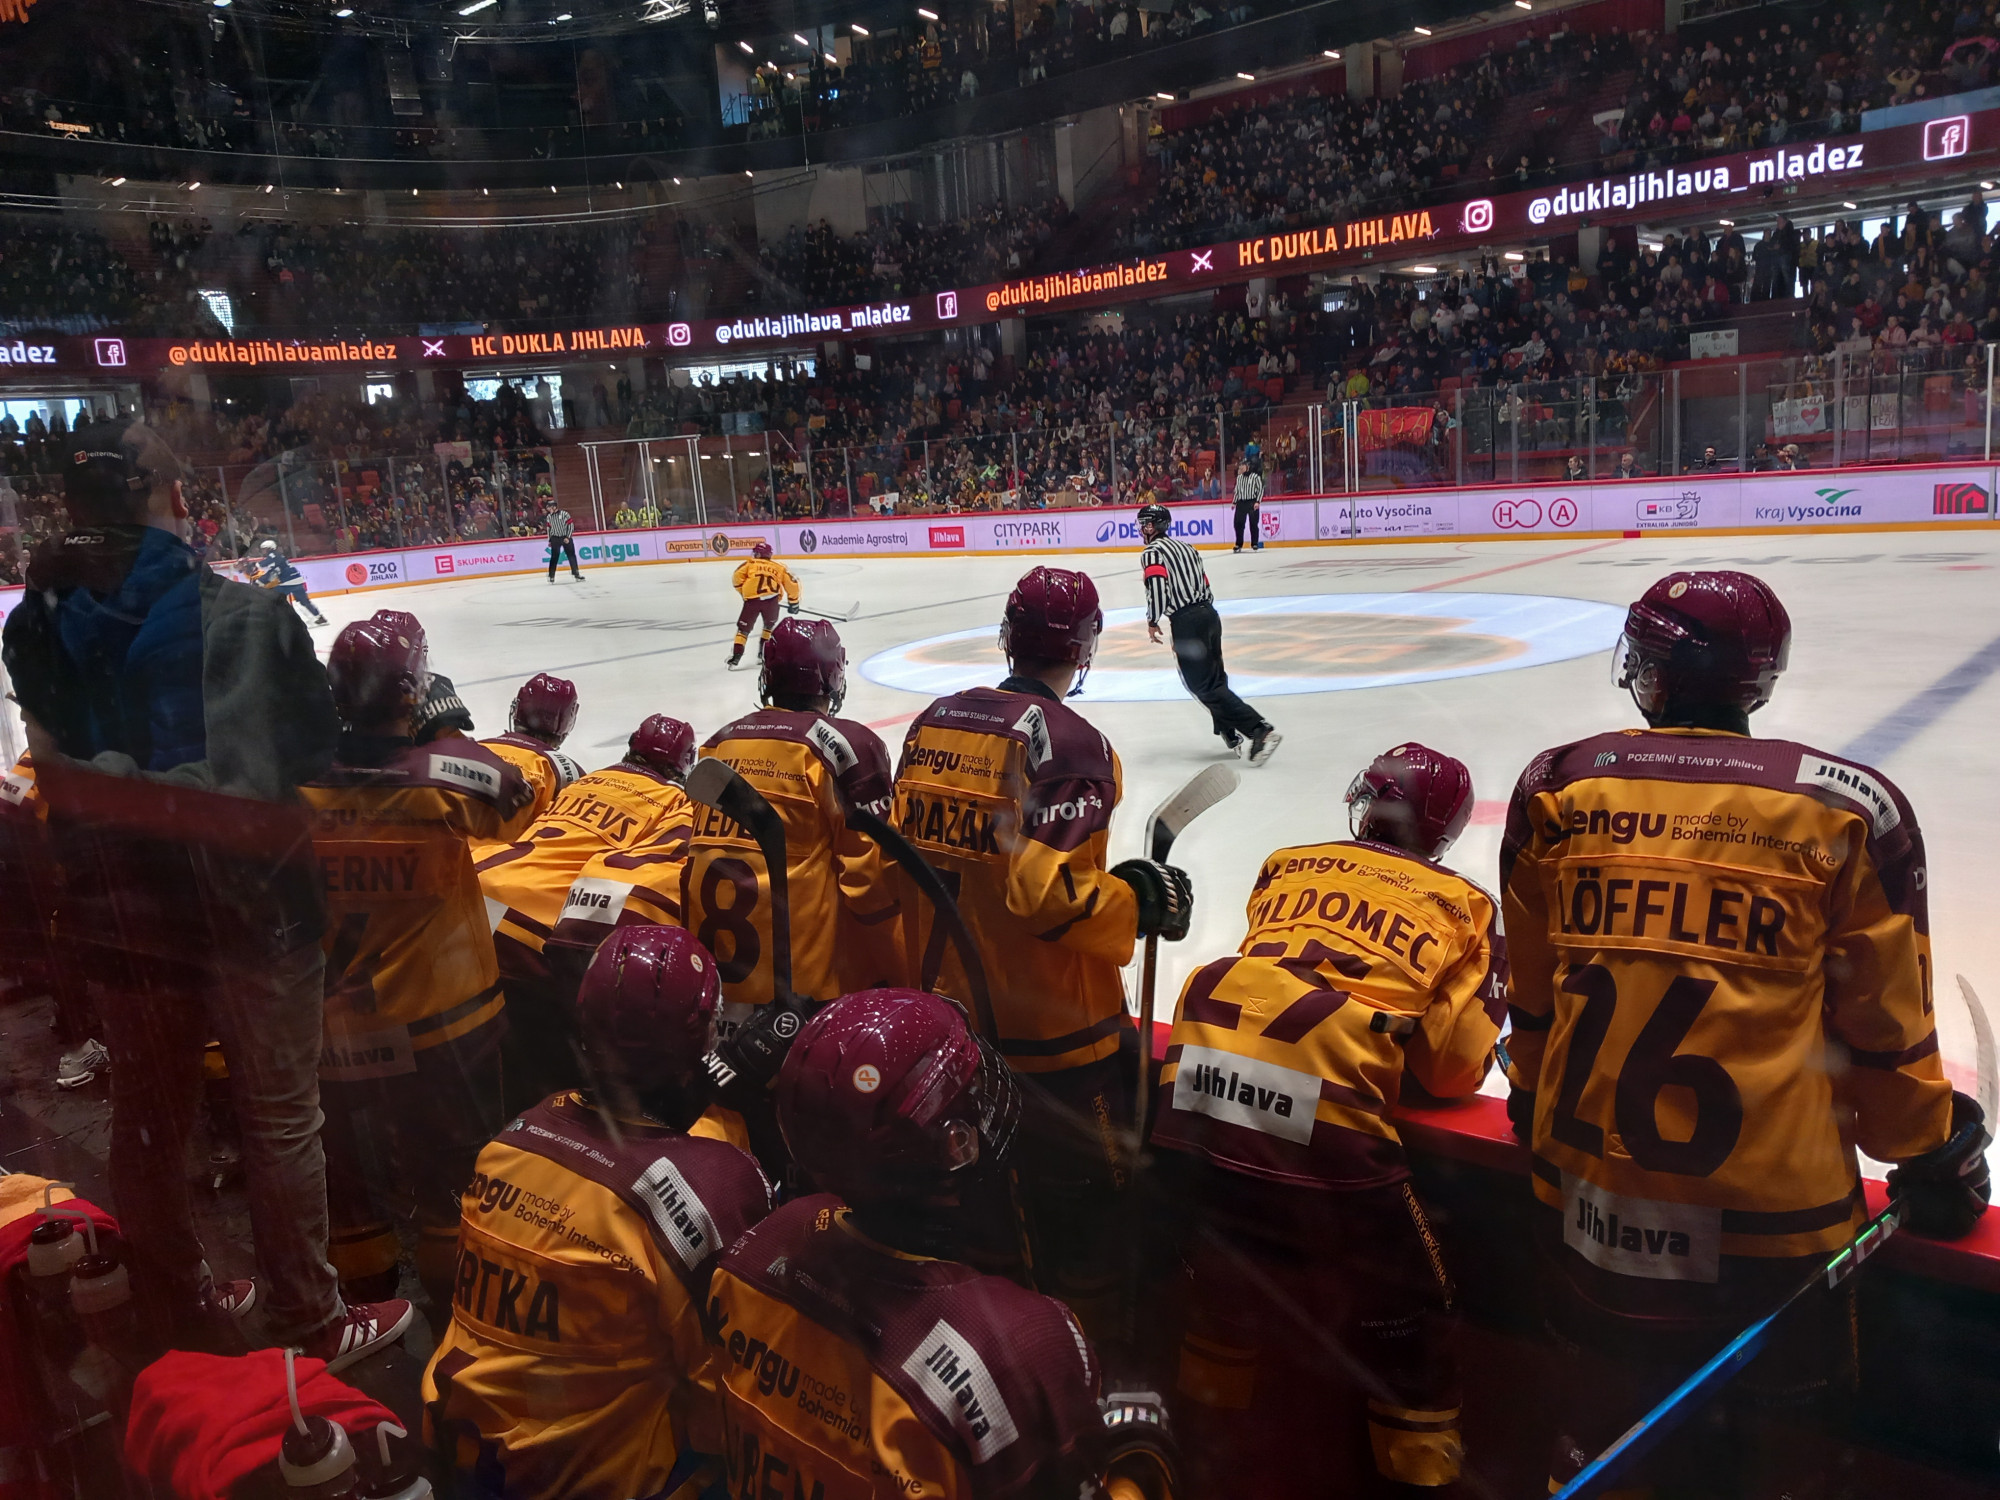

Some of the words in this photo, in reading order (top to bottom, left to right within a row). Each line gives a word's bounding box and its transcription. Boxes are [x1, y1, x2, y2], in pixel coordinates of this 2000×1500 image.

[1528, 143, 1864, 224] @duklajihlava_mladez
[1238, 241, 1265, 267] HC
[1270, 229, 1338, 261] DUKLA
[1344, 211, 1433, 250] JIHLAVA
[716, 303, 912, 344] @duklajihlava_mladez
[471, 335, 497, 356] HC
[502, 332, 565, 354] DUKLA
[570, 327, 645, 352] JIHLAVA
[1339, 507, 1373, 519] Auto
[1375, 504, 1432, 521] Vysočina
[1658, 505, 1672, 513] KB
[1756, 506, 1785, 522] Kraj
[822, 533, 865, 546] Akademie
[866, 531, 909, 547] Agrostroj
[933, 532, 960, 544] Jihlava
[993, 521, 1061, 538] CITYPARK
[1118, 519, 1214, 539] DEHLON
[1636, 521, 1669, 529] EXTRALIGA
[456, 554, 496, 568] SKUPINA
[498, 552, 516, 564] ČEZ
[668, 539, 711, 553] Agrostroj
[369, 561, 397, 575] ZOO
[370, 571, 399, 582] JIHLAVA
[816, 726, 846, 763] Jihlava
[441, 761, 493, 786] Jihlava
[738, 765, 775, 778] Bohemia
[741, 757, 764, 766] made
[765, 760, 777, 769] by
[1626, 752, 1676, 764] POZEMNÍ
[1677, 754, 1723, 767] STAVBY
[1724, 757, 1765, 772] Jihlava
[1815, 763, 1888, 818] Jihlava
[903, 796, 1001, 855] PRAŽÁK
[1674, 810, 1722, 827] made
[1726, 811, 1749, 832] by
[1671, 826, 1747, 844] Bohemia
[1750, 832, 1836, 867] Interactive
[320, 847, 420, 892] ERNÝ
[1357, 868, 1410, 894] Bohemia
[1361, 864, 1396, 876] made
[1398, 871, 1415, 884] by
[1557, 867, 1786, 956] LÖFFLER
[1550, 962, 1743, 1178] 26
[1192, 1063, 1294, 1119] Jihlava
[526, 1123, 554, 1143] POZEMNÍ
[554, 1132, 587, 1154] STAVBY
[586, 1147, 616, 1168] Jihlava
[521, 1190, 560, 1215] made
[560, 1207, 576, 1222] by
[651, 1175, 705, 1250] Jihlava
[513, 1205, 566, 1237] Bohemia
[566, 1226, 646, 1276] Interactive
[1577, 1197, 1691, 1258] Jihlava
[802, 1372, 846, 1406] made
[924, 1343, 992, 1442] Jihlava
[797, 1389, 862, 1441] Bohemia
